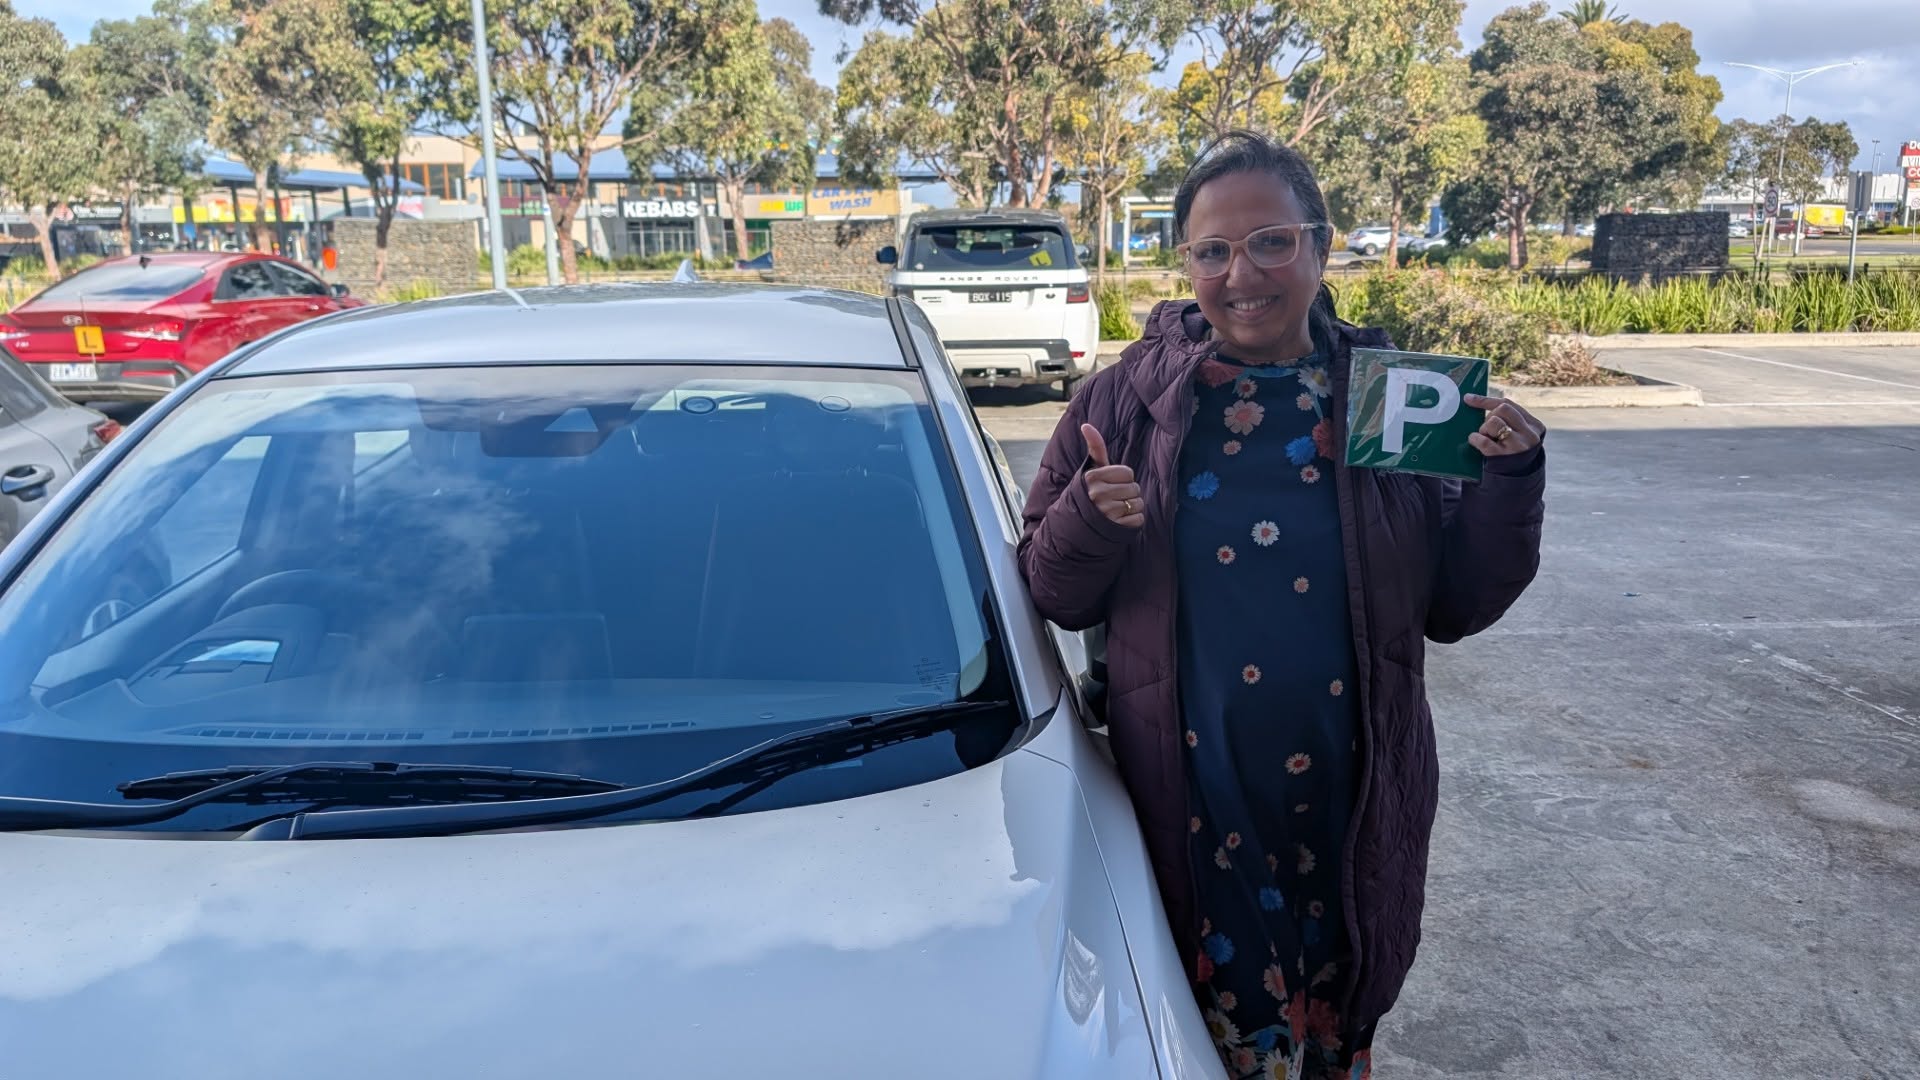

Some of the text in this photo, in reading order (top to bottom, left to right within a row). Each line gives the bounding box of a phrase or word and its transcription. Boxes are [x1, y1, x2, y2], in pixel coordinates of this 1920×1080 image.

[623, 201, 699, 218] KEBABS
[830, 197, 872, 210] WASH
[83, 331, 97, 348] L
[1382, 367, 1461, 454] P
